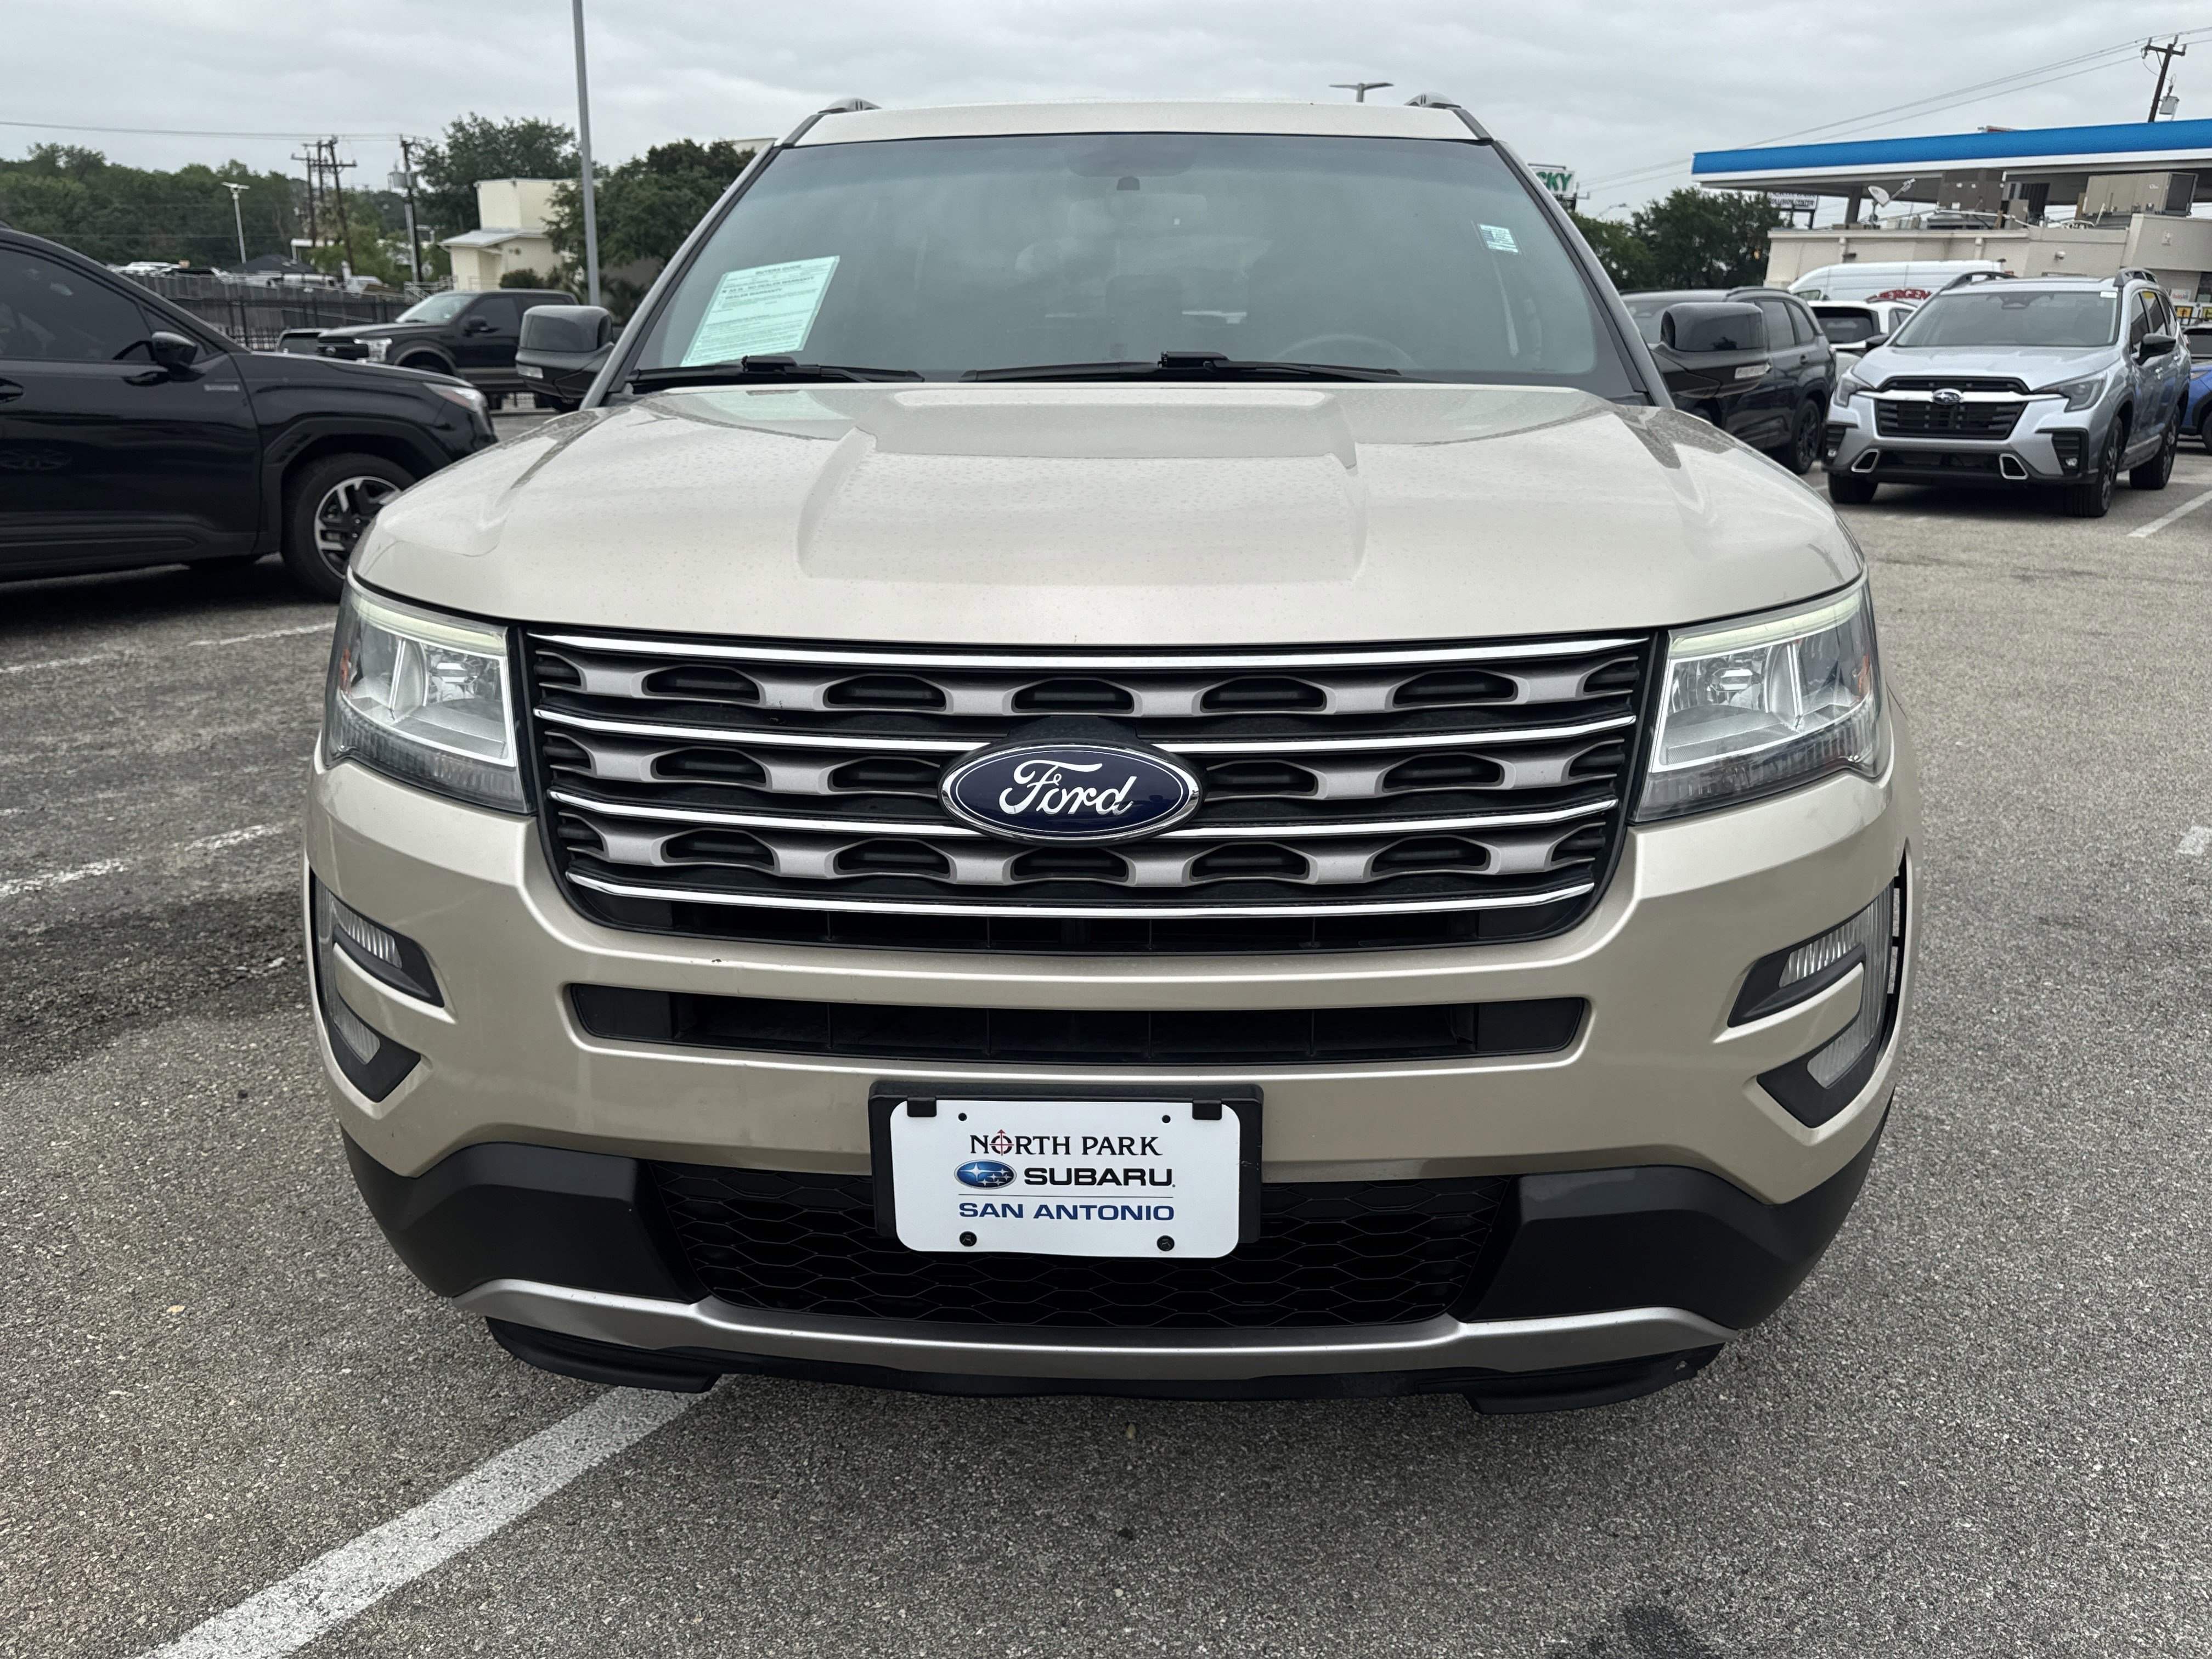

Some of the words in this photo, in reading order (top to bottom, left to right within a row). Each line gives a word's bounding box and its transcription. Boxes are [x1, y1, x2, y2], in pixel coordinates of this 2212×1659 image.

[998, 759, 1137, 815] Ford
[969, 1132, 1071, 1156] NORTH
[1081, 1136, 1164, 1156] PARK
[1024, 1167, 1172, 1186] SUBARU
[959, 1203, 1024, 1218] SAN
[1033, 1204, 1175, 1221] ANTONIO
